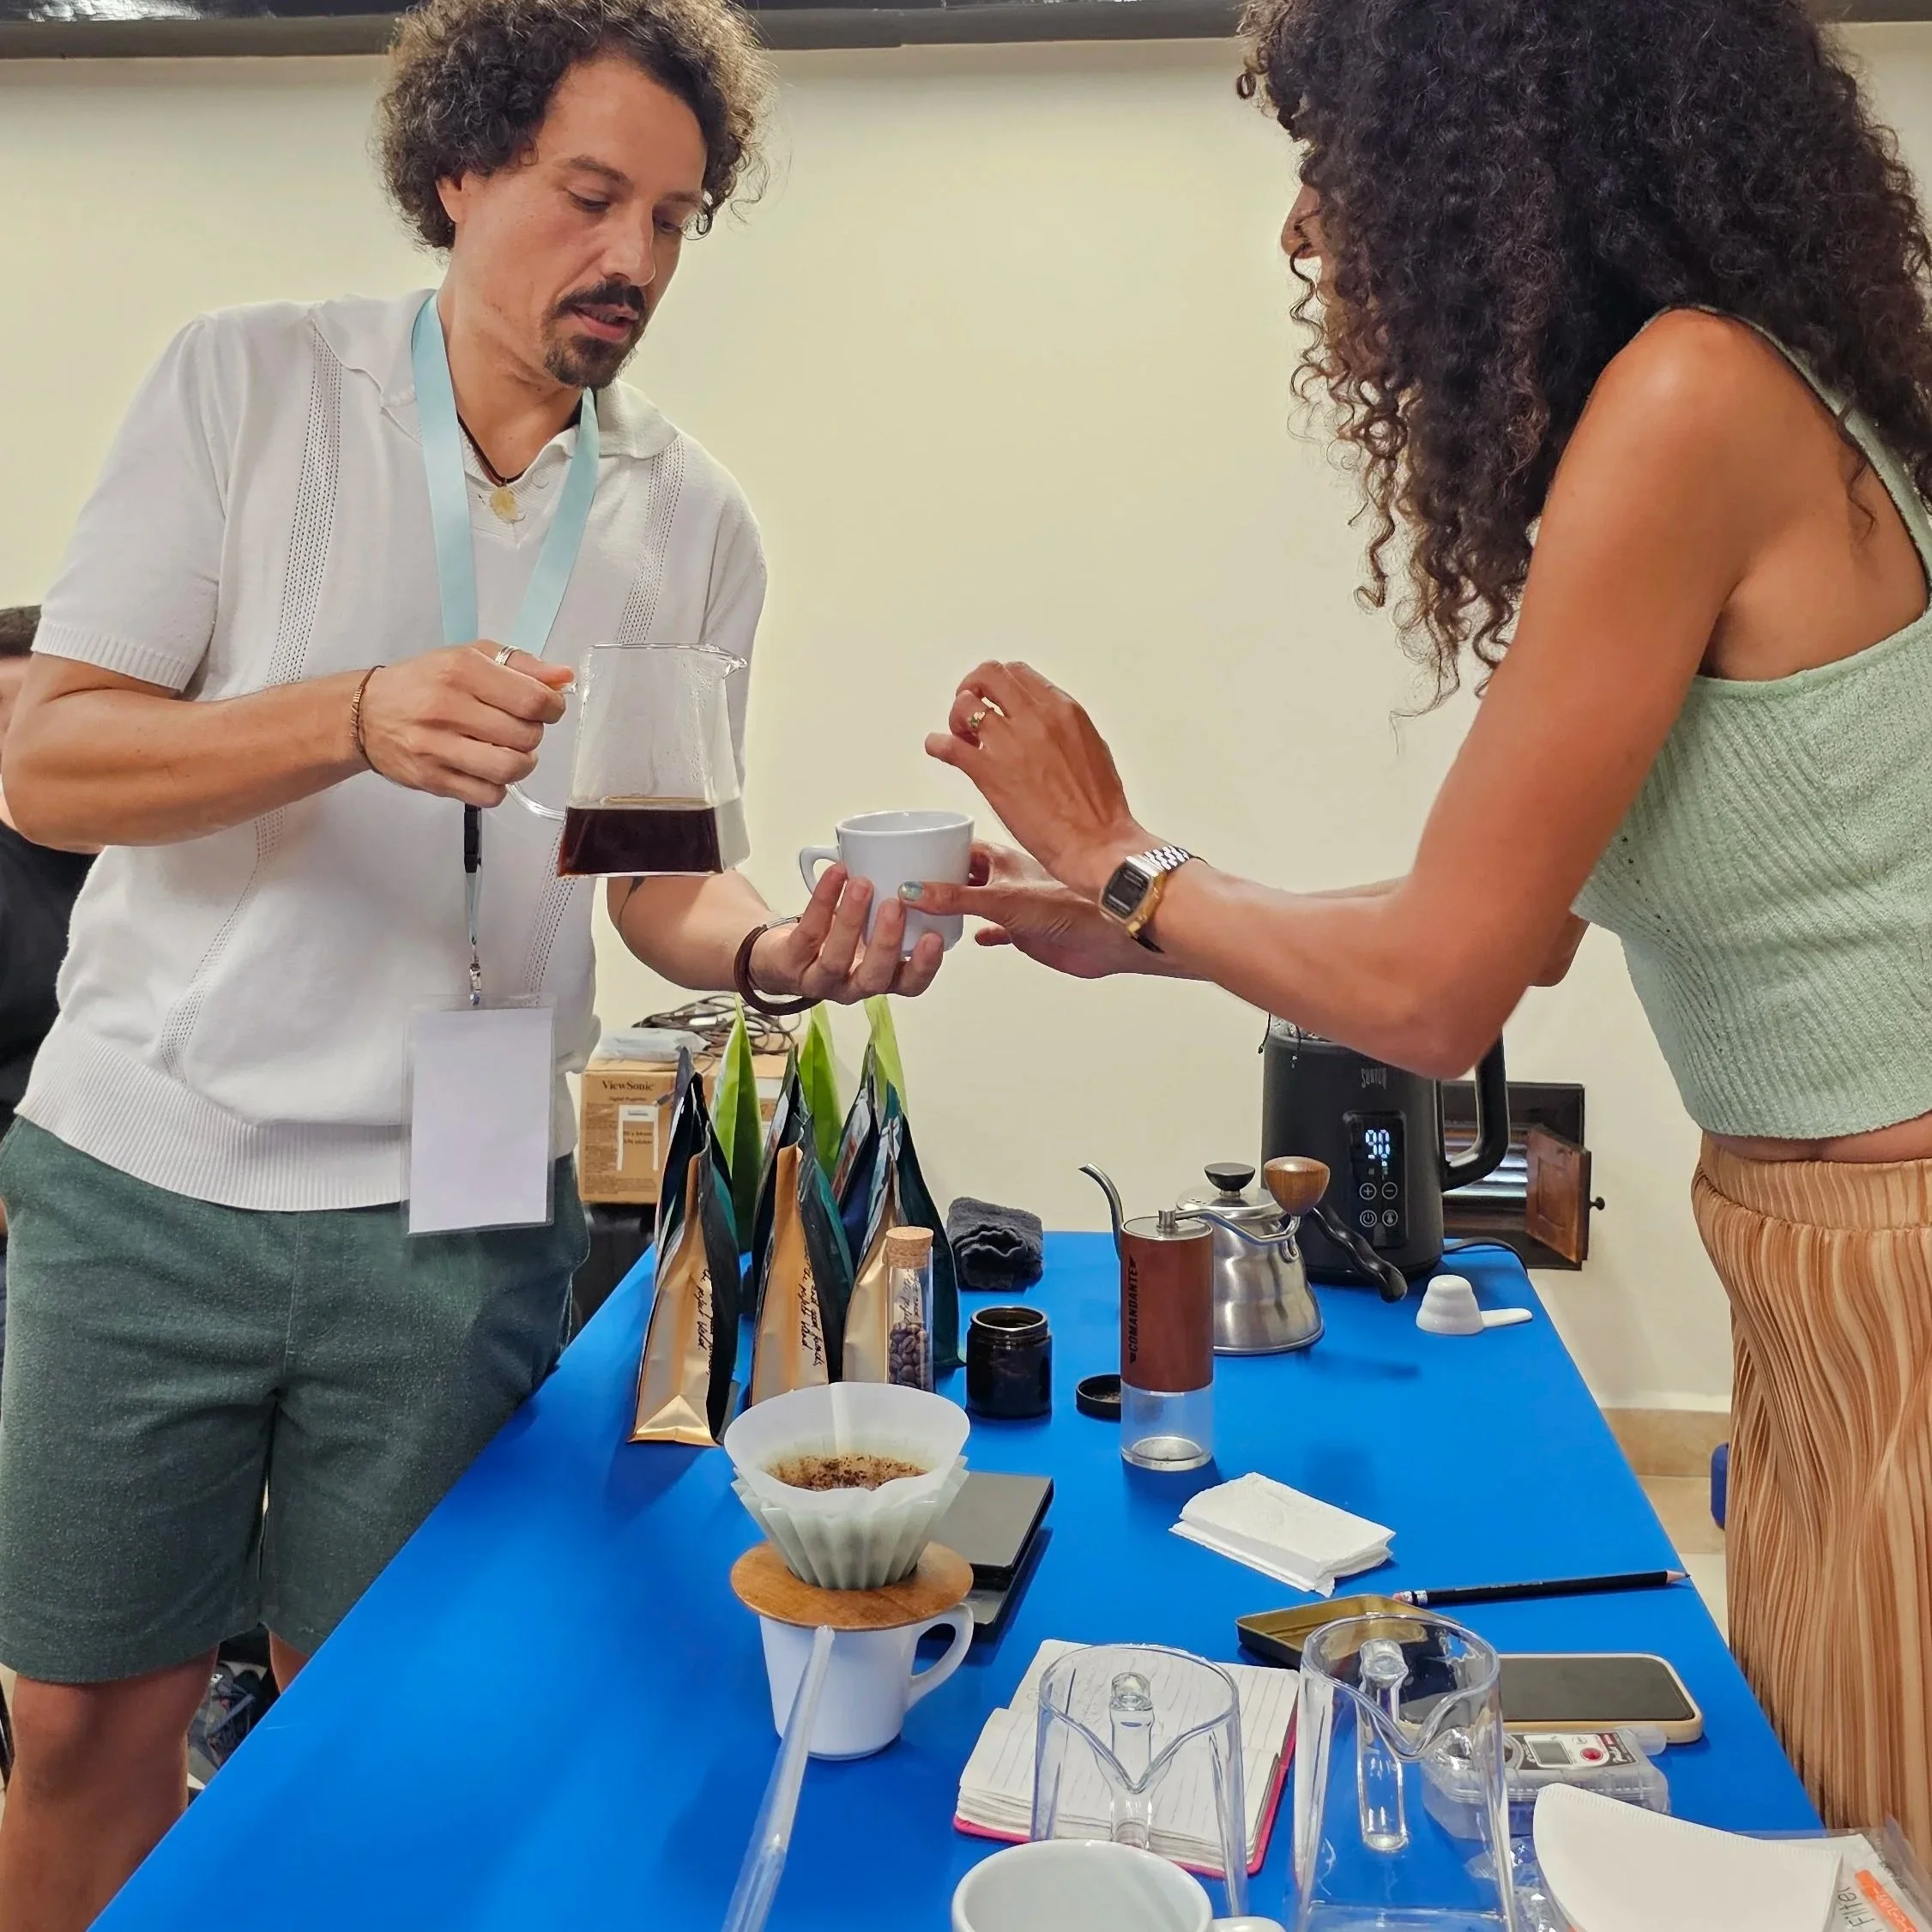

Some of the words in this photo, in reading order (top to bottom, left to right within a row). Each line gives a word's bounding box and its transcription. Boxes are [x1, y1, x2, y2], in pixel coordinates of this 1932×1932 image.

[601, 1080, 655, 1091] ViewSonic
[1365, 1129, 1391, 1159] 90
[1127, 1268, 1138, 1352] COMANDANTE
[1837, 1887, 1875, 1927] Filter
